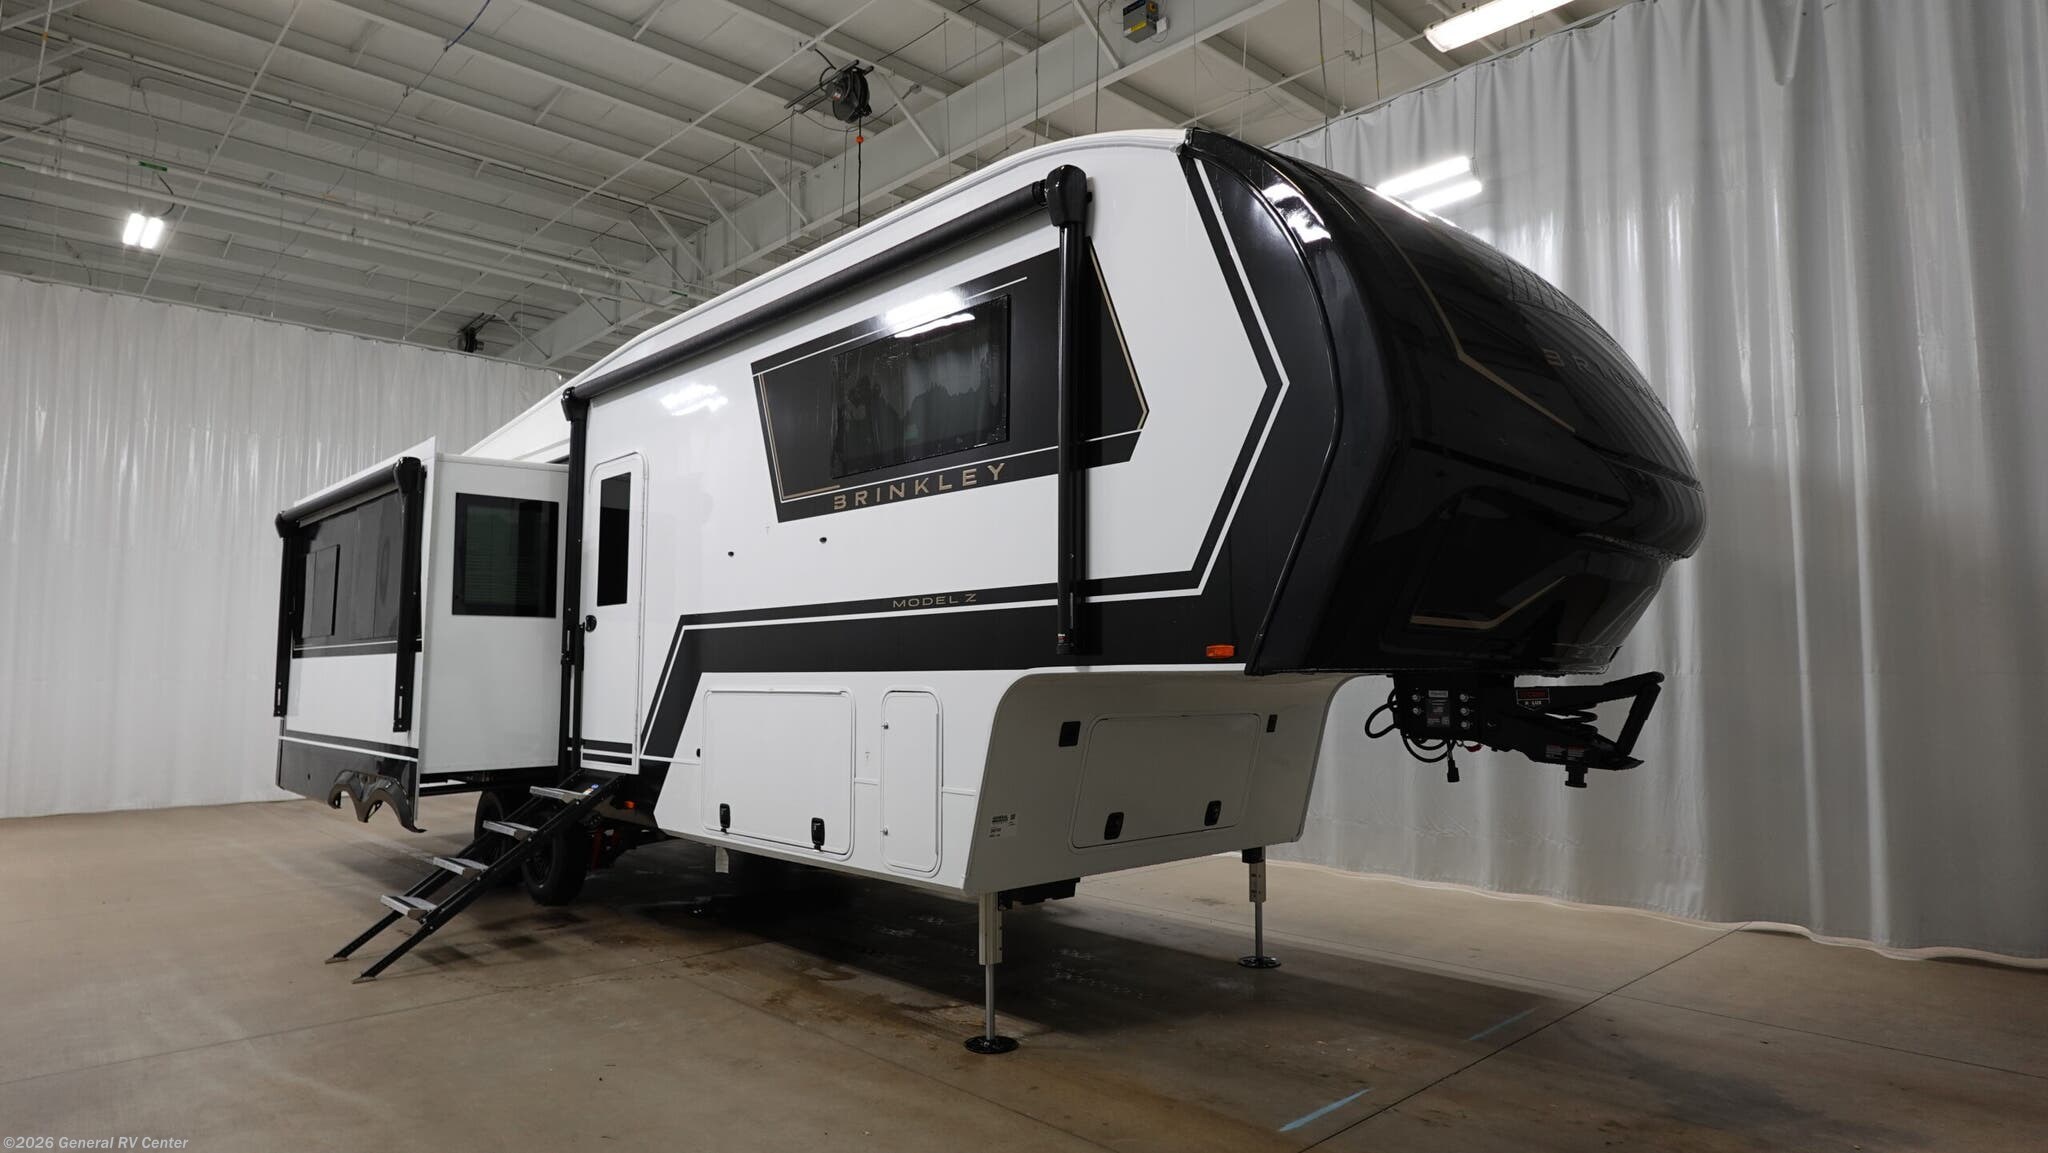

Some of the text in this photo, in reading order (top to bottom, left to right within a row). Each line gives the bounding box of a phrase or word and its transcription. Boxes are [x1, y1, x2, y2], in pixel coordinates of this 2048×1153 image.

[834, 463, 1005, 510] BRINKLEY
[893, 593, 977, 608] MODEL Z
